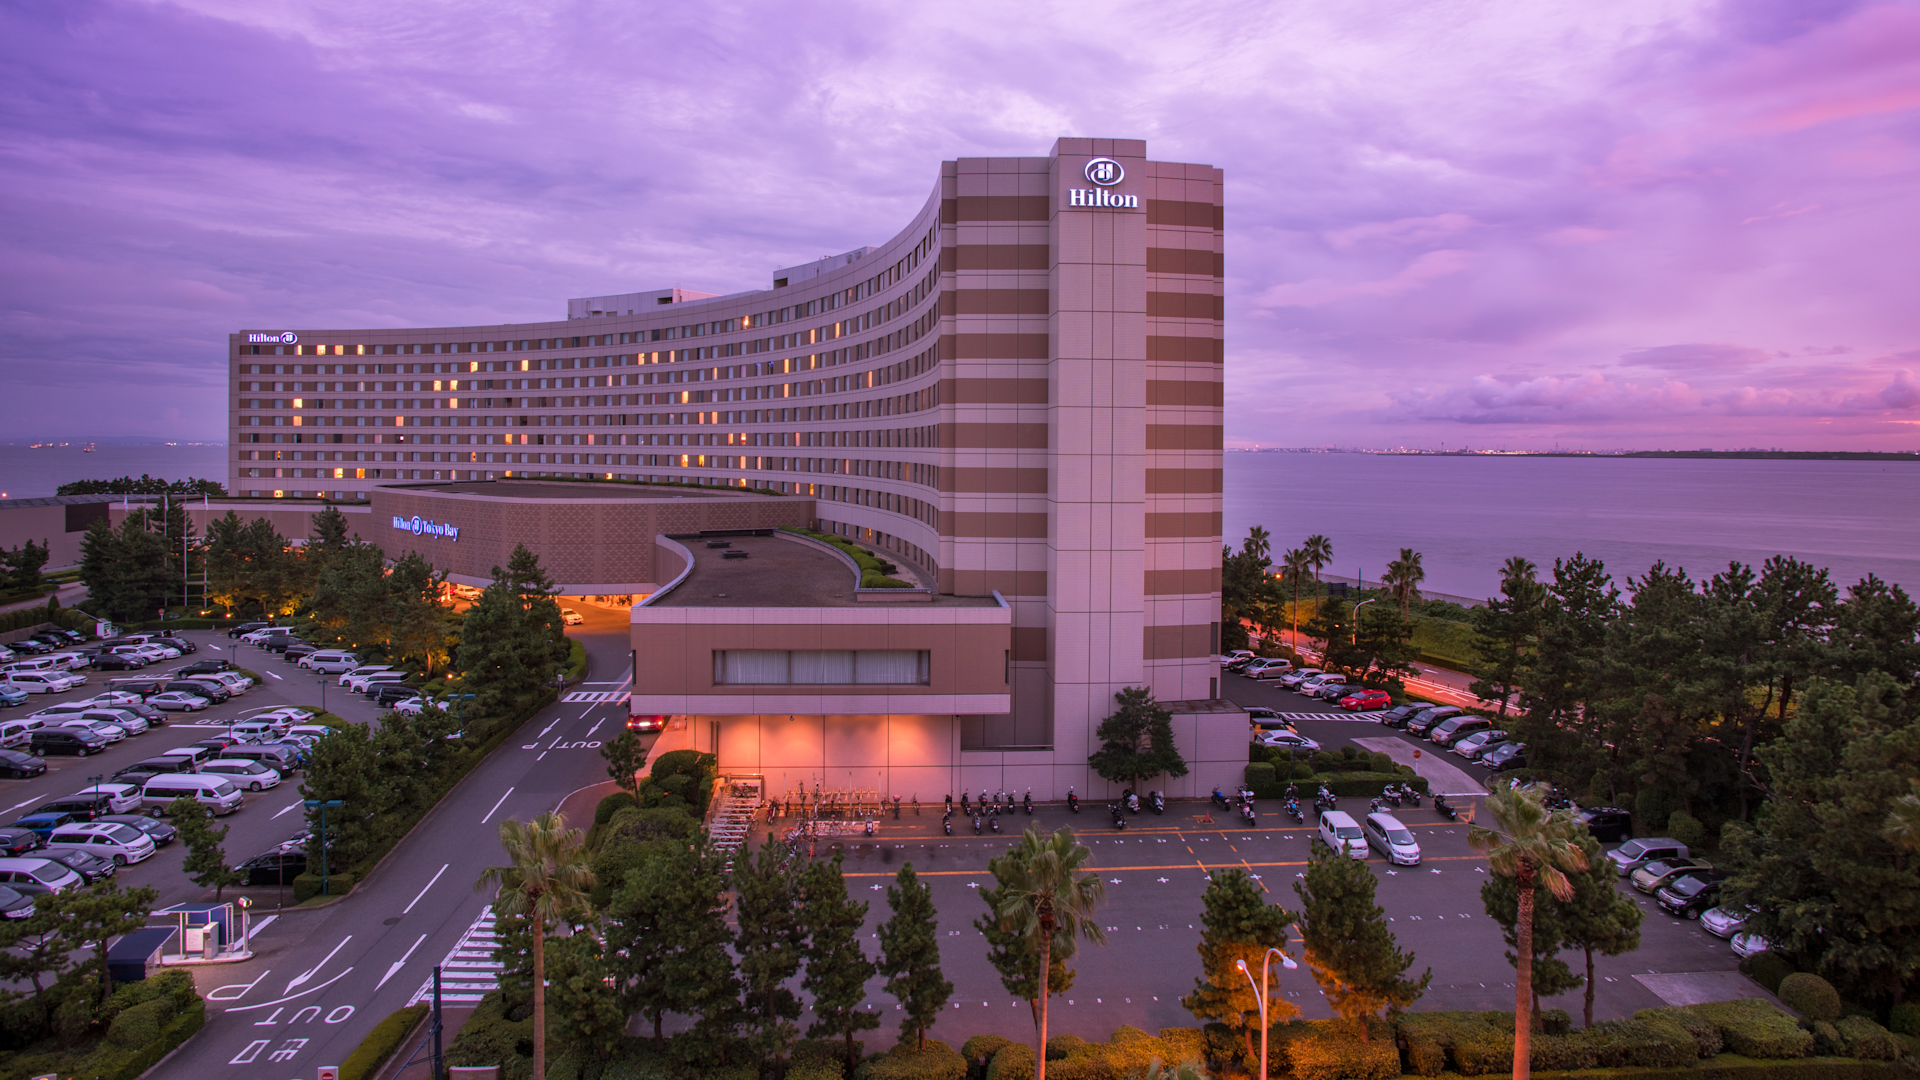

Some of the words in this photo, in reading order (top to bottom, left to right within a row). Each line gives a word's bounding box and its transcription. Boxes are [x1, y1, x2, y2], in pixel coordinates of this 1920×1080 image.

[1069, 187, 1138, 208] Hilton
[248, 333, 280, 343] Hilton
[392, 516, 411, 531] Hilton
[422, 520, 444, 539] Tokyo
[444, 523, 459, 542] Bay
[555, 741, 601, 749] OUT
[206, 969, 271, 1000] P
[253, 1005, 355, 1026] OUT
